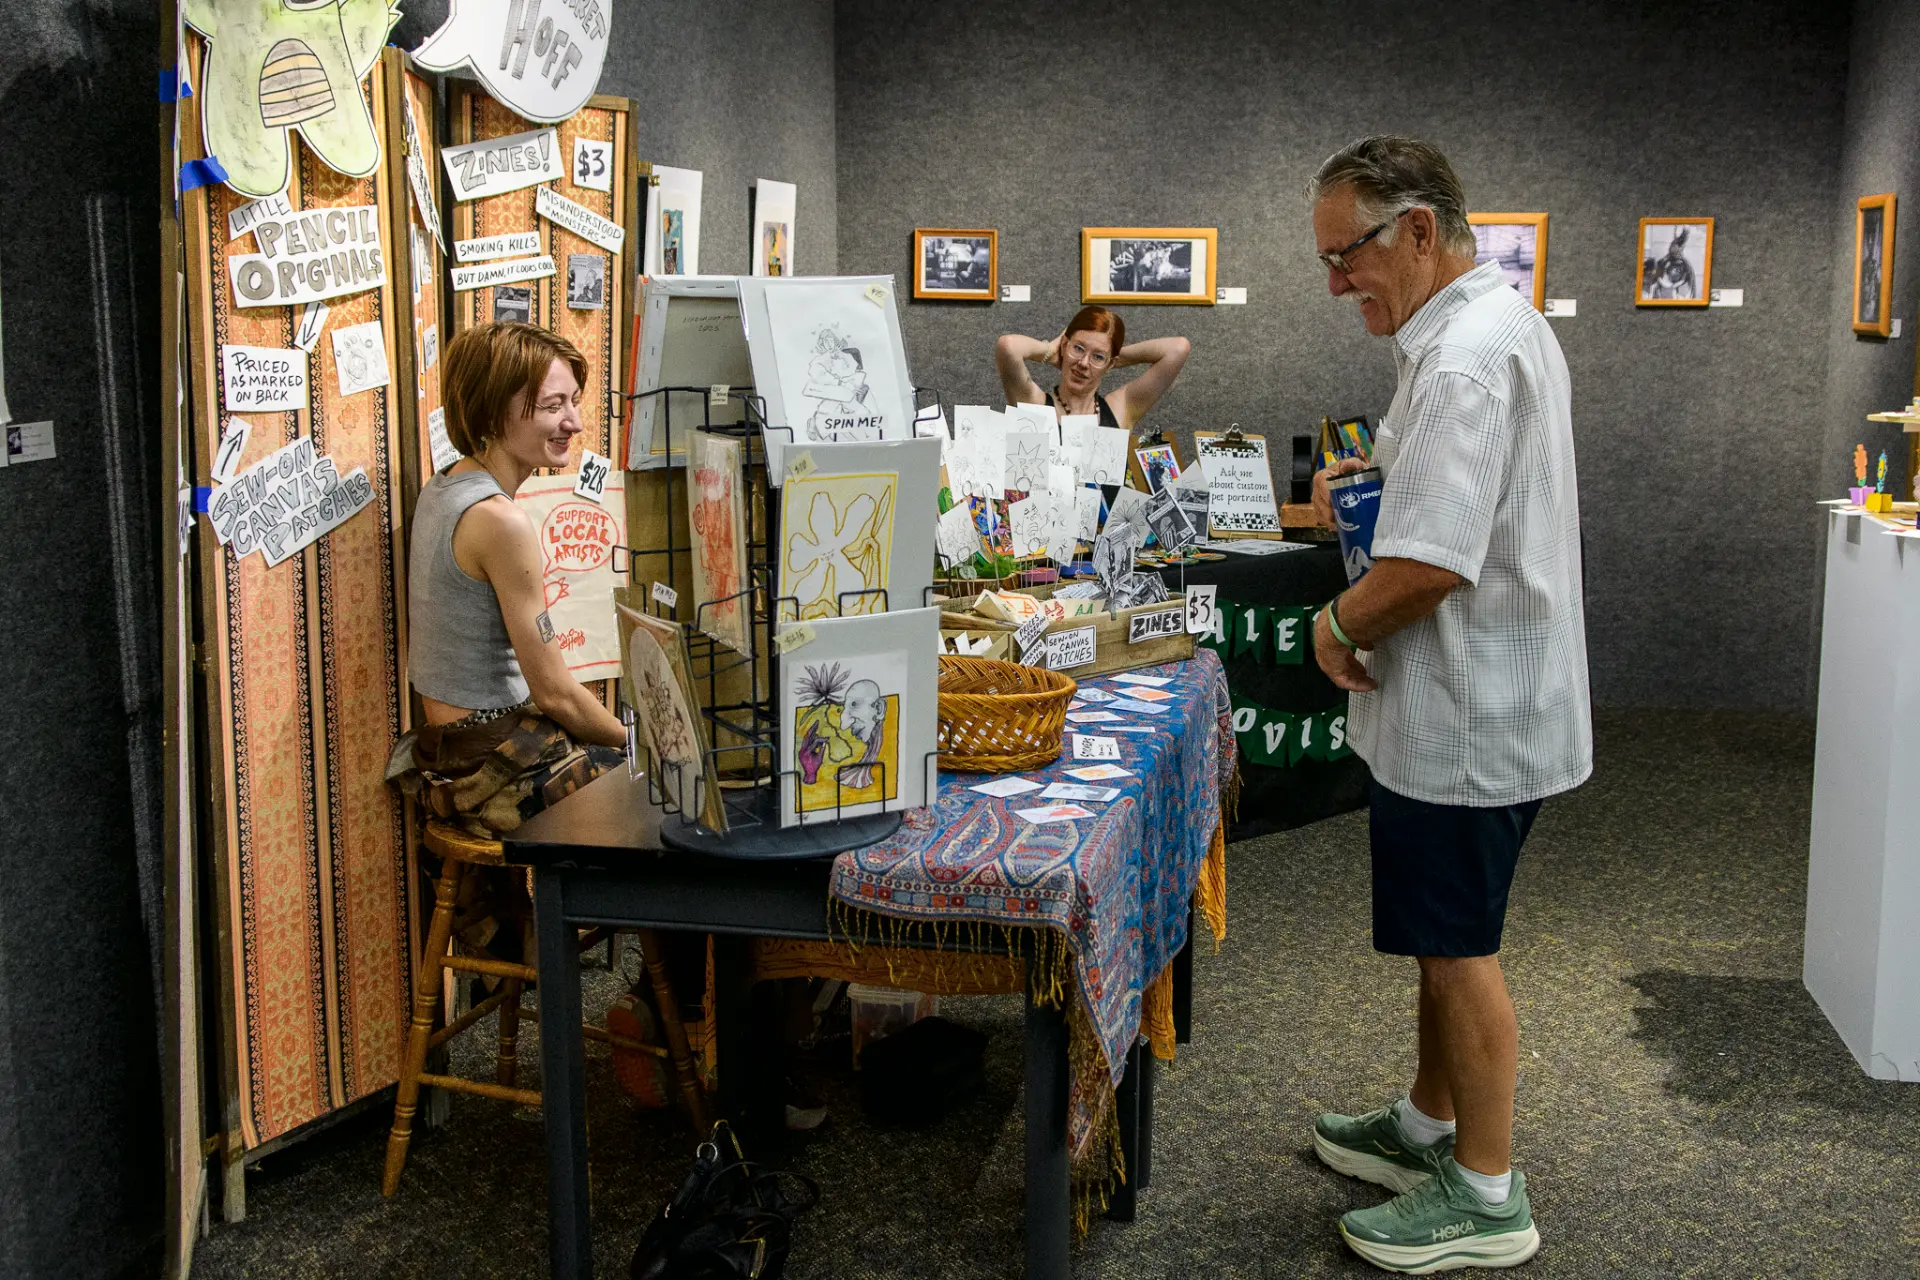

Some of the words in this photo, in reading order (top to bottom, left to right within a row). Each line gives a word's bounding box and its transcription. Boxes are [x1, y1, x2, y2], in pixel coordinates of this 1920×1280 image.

[562, 0, 606, 41] RET
[499, 0, 583, 90] HOFF
[451, 132, 550, 192] ZINES!
[578, 144, 605, 183] $3
[230, 198, 291, 232] LITTLE
[539, 187, 622, 240] MISUNDERSTOOD
[256, 209, 376, 259] PENCIL
[459, 240, 504, 257] SMOKING
[509, 236, 538, 250] KILLS
[237, 248, 383, 301] ORIGINALS
[457, 273, 475, 286] BUT
[478, 269, 506, 282] DAMN,
[506, 266, 515, 276] IT
[516, 264, 537, 274] LOOKS
[538, 261, 554, 271] COOL
[231, 351, 290, 374] PRICED
[231, 375, 246, 389] AS
[249, 375, 303, 387] MARKED
[235, 390, 251, 402] ON
[255, 389, 288, 405] BACK
[824, 418, 854, 429] SPIN
[857, 416, 883, 429] ME!
[580, 455, 607, 495] $28
[1208, 477, 1234, 489] about
[1236, 481, 1268, 490] custom
[1220, 465, 1240, 481] Ask
[212, 439, 312, 538] SEW-ON
[1211, 493, 1224, 504] pet
[1227, 493, 1270, 505] portraits!
[233, 458, 338, 555] CANVAS
[262, 472, 371, 560] PATCHES
[555, 508, 609, 528] SUPPORT
[549, 524, 611, 547] LOCAL
[554, 544, 604, 564] ARTISTS
[1189, 590, 1211, 625] $3
[1020, 614, 1039, 637] PRICES
[1132, 612, 1181, 639] ZINES
[1049, 631, 1079, 647] SEW-ON
[1059, 637, 1090, 652] CANVAS
[1049, 647, 1092, 667] PATCHES
[1432, 1219, 1476, 1242] HOKA
